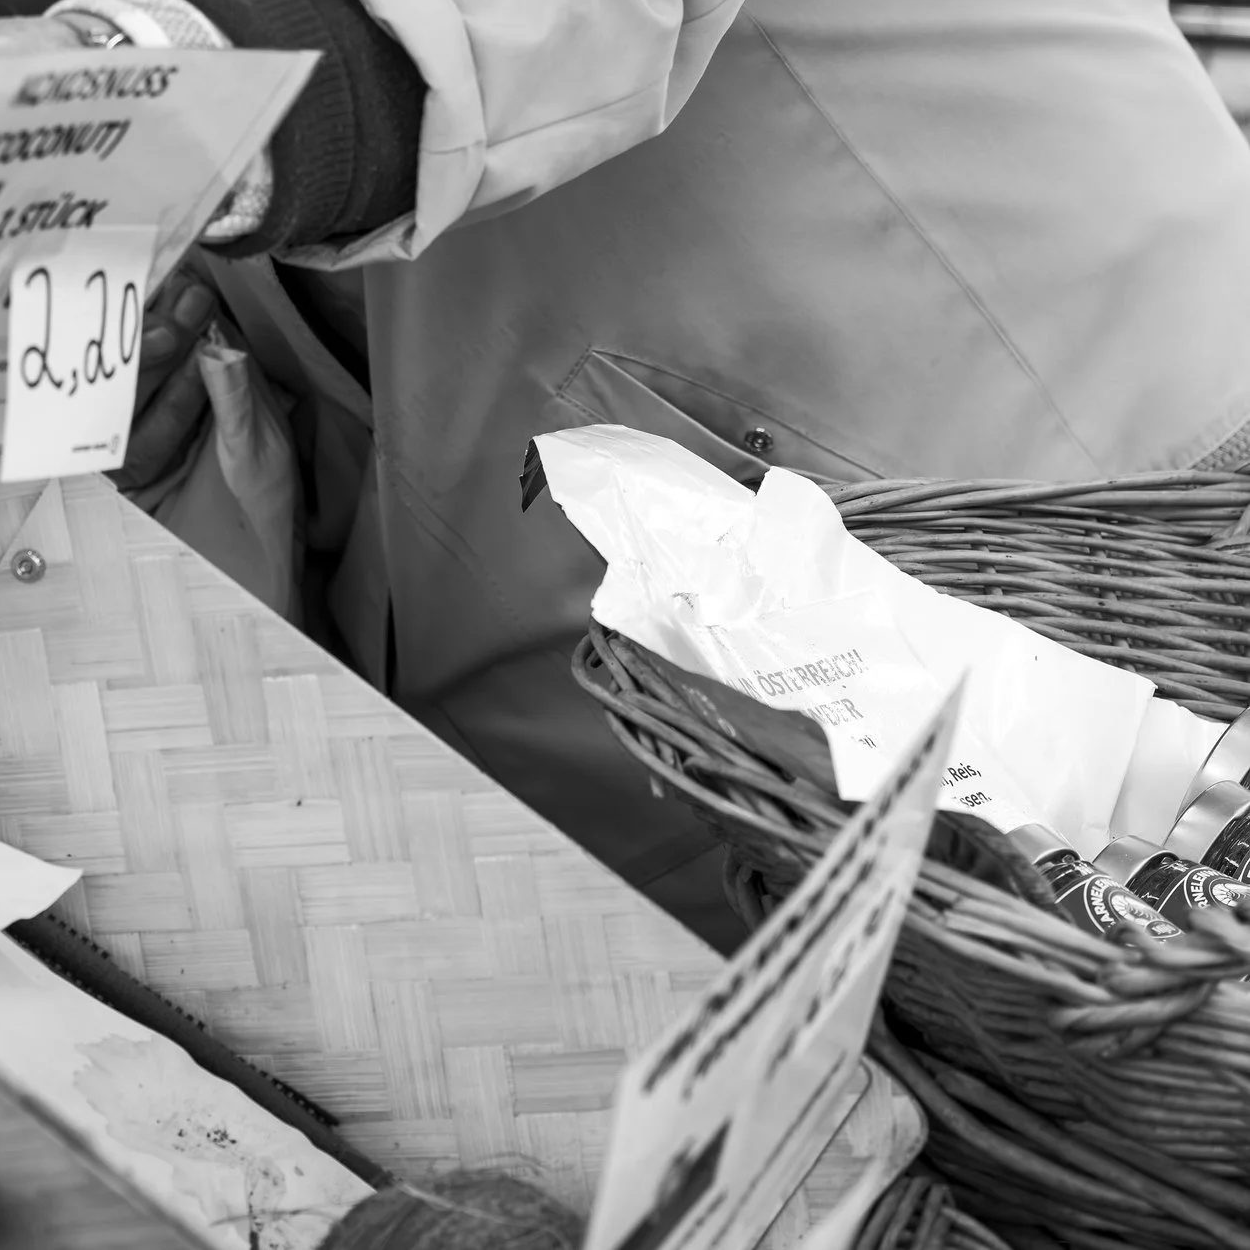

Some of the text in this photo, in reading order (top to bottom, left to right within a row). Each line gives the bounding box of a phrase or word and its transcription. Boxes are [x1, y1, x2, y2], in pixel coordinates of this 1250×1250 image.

[8, 191, 109, 239] STÜCK
[20, 265, 140, 397] 2,20
[752, 648, 869, 698] ÖSTERREICH!
[806, 697, 865, 727] NDER
[946, 762, 982, 782] Reis,
